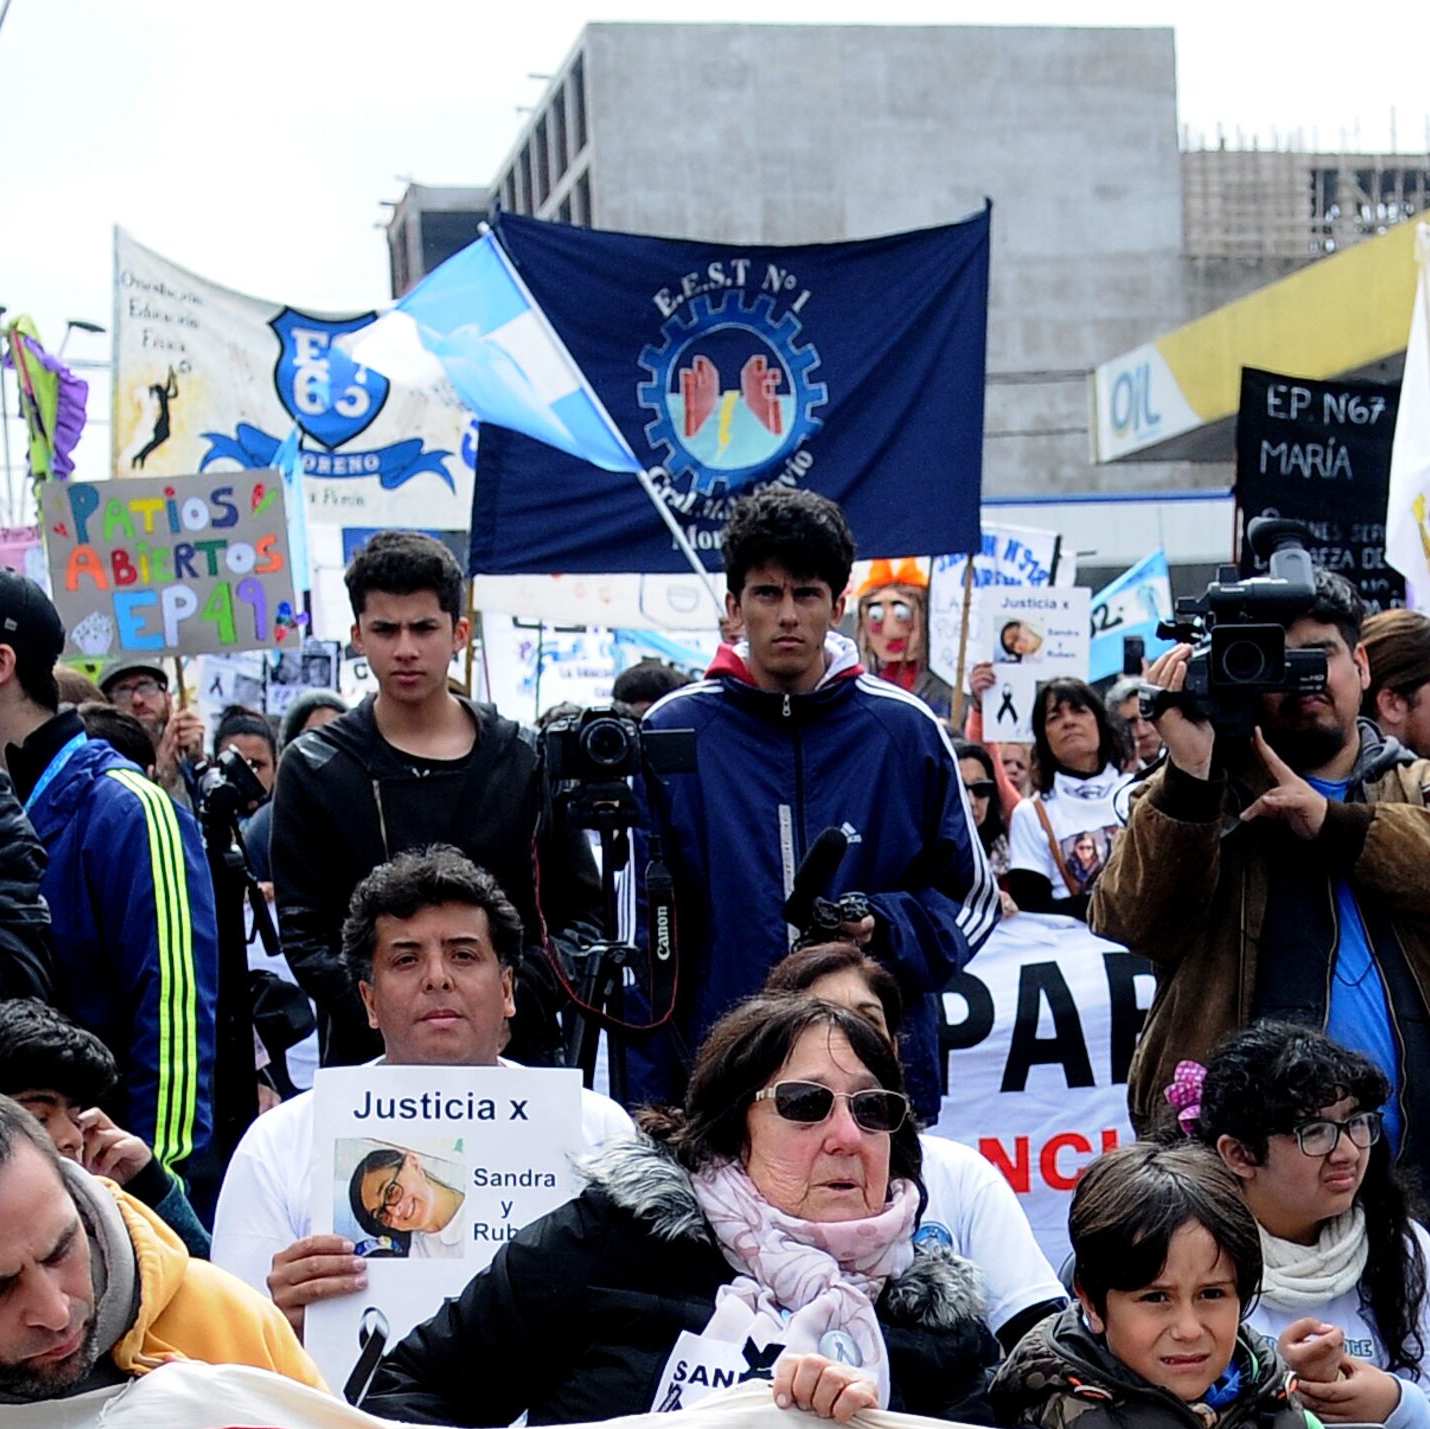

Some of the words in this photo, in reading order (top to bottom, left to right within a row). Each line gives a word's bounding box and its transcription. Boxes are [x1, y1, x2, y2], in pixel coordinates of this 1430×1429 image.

[303, 454, 380, 475] ORENO
[1259, 436, 1353, 480] MARÍA
[657, 905, 671, 961] Canon
[352, 1090, 496, 1121] Justicia
[508, 1097, 529, 1121] x
[473, 1166, 557, 1188] Sandra
[501, 1200, 513, 1219] y
